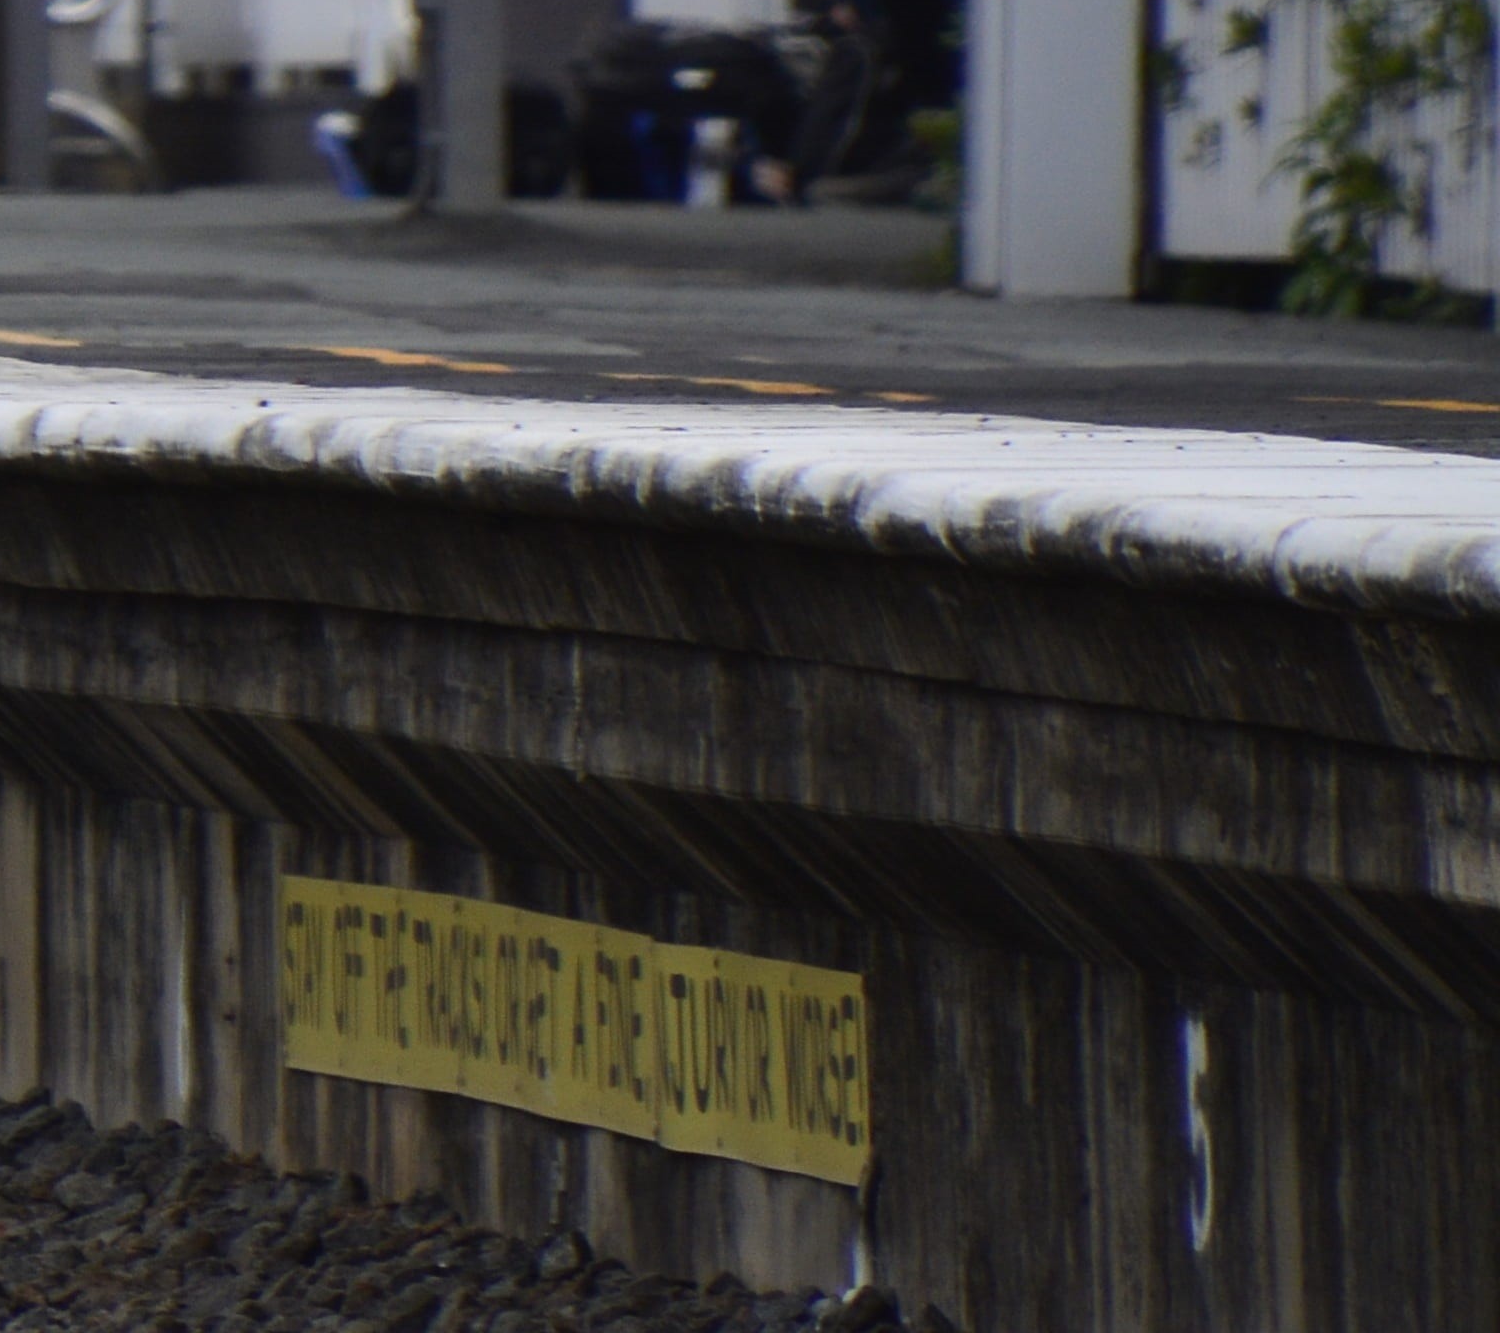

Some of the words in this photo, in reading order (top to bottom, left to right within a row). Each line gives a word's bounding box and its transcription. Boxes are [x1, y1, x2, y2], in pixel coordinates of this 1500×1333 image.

[332, 904, 365, 1041] OFF
[369, 908, 412, 1050] THE
[412, 918, 490, 1062] TRACKS
[494, 933, 521, 1067] OR
[525, 935, 562, 1080] GET
[571, 954, 589, 1082] A
[745, 984, 774, 1124] OR
